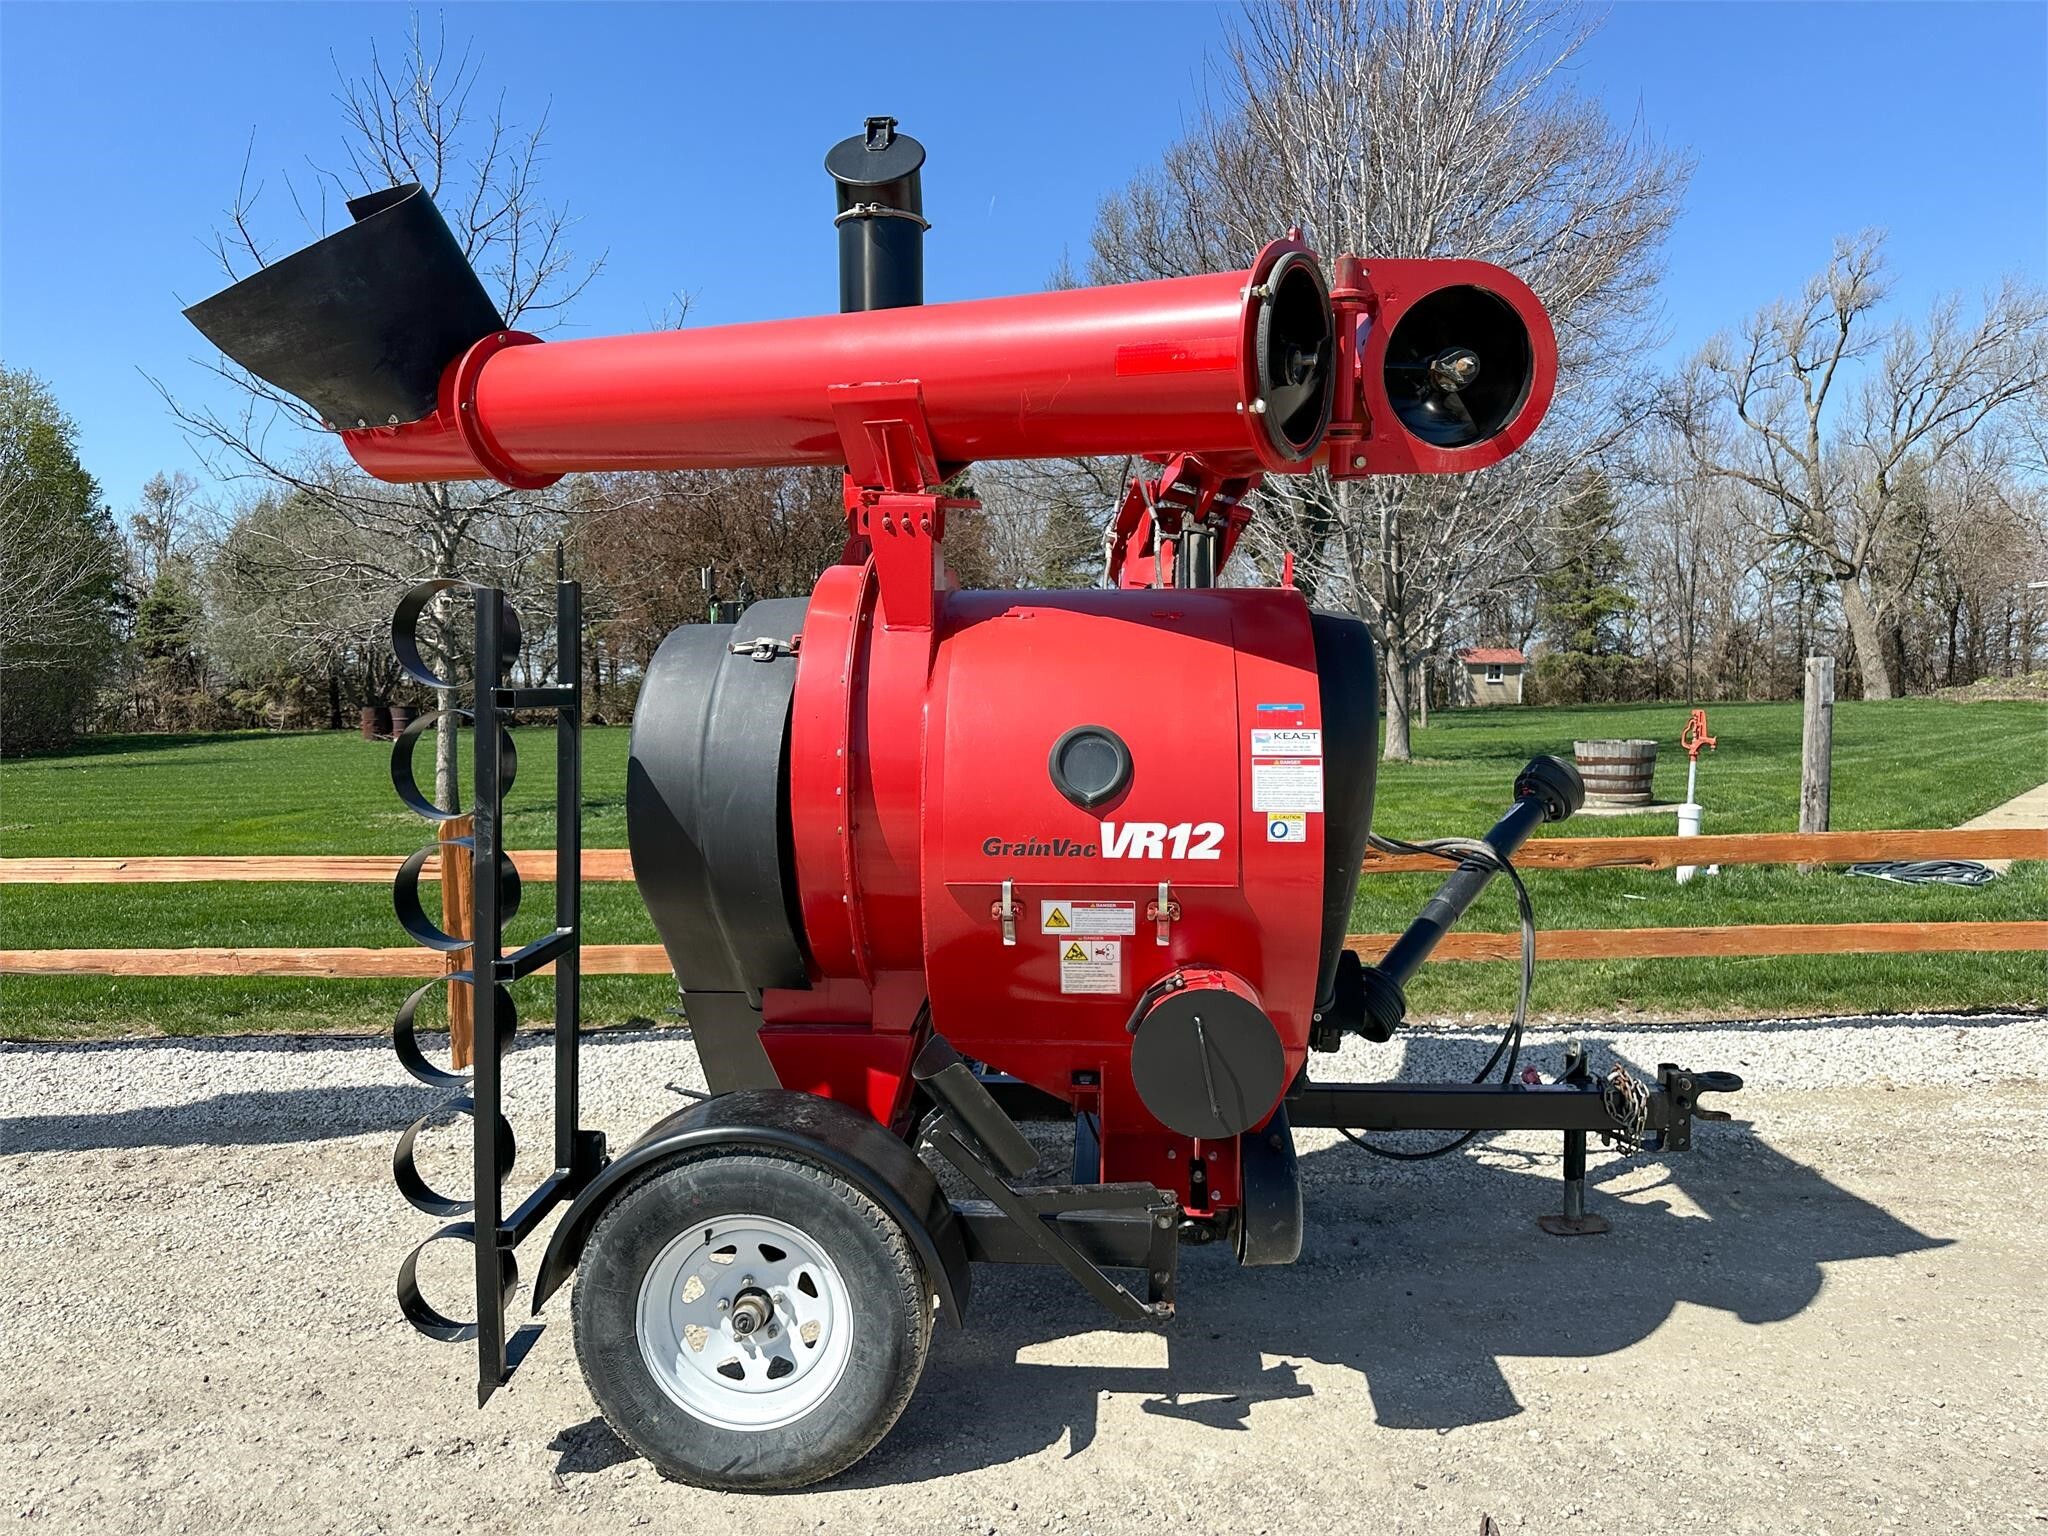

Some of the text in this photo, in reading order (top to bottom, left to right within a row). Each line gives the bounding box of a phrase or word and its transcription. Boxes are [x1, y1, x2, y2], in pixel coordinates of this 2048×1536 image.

[1273, 732, 1318, 740] KEAST
[983, 822, 1224, 859] GrainVac VR12
